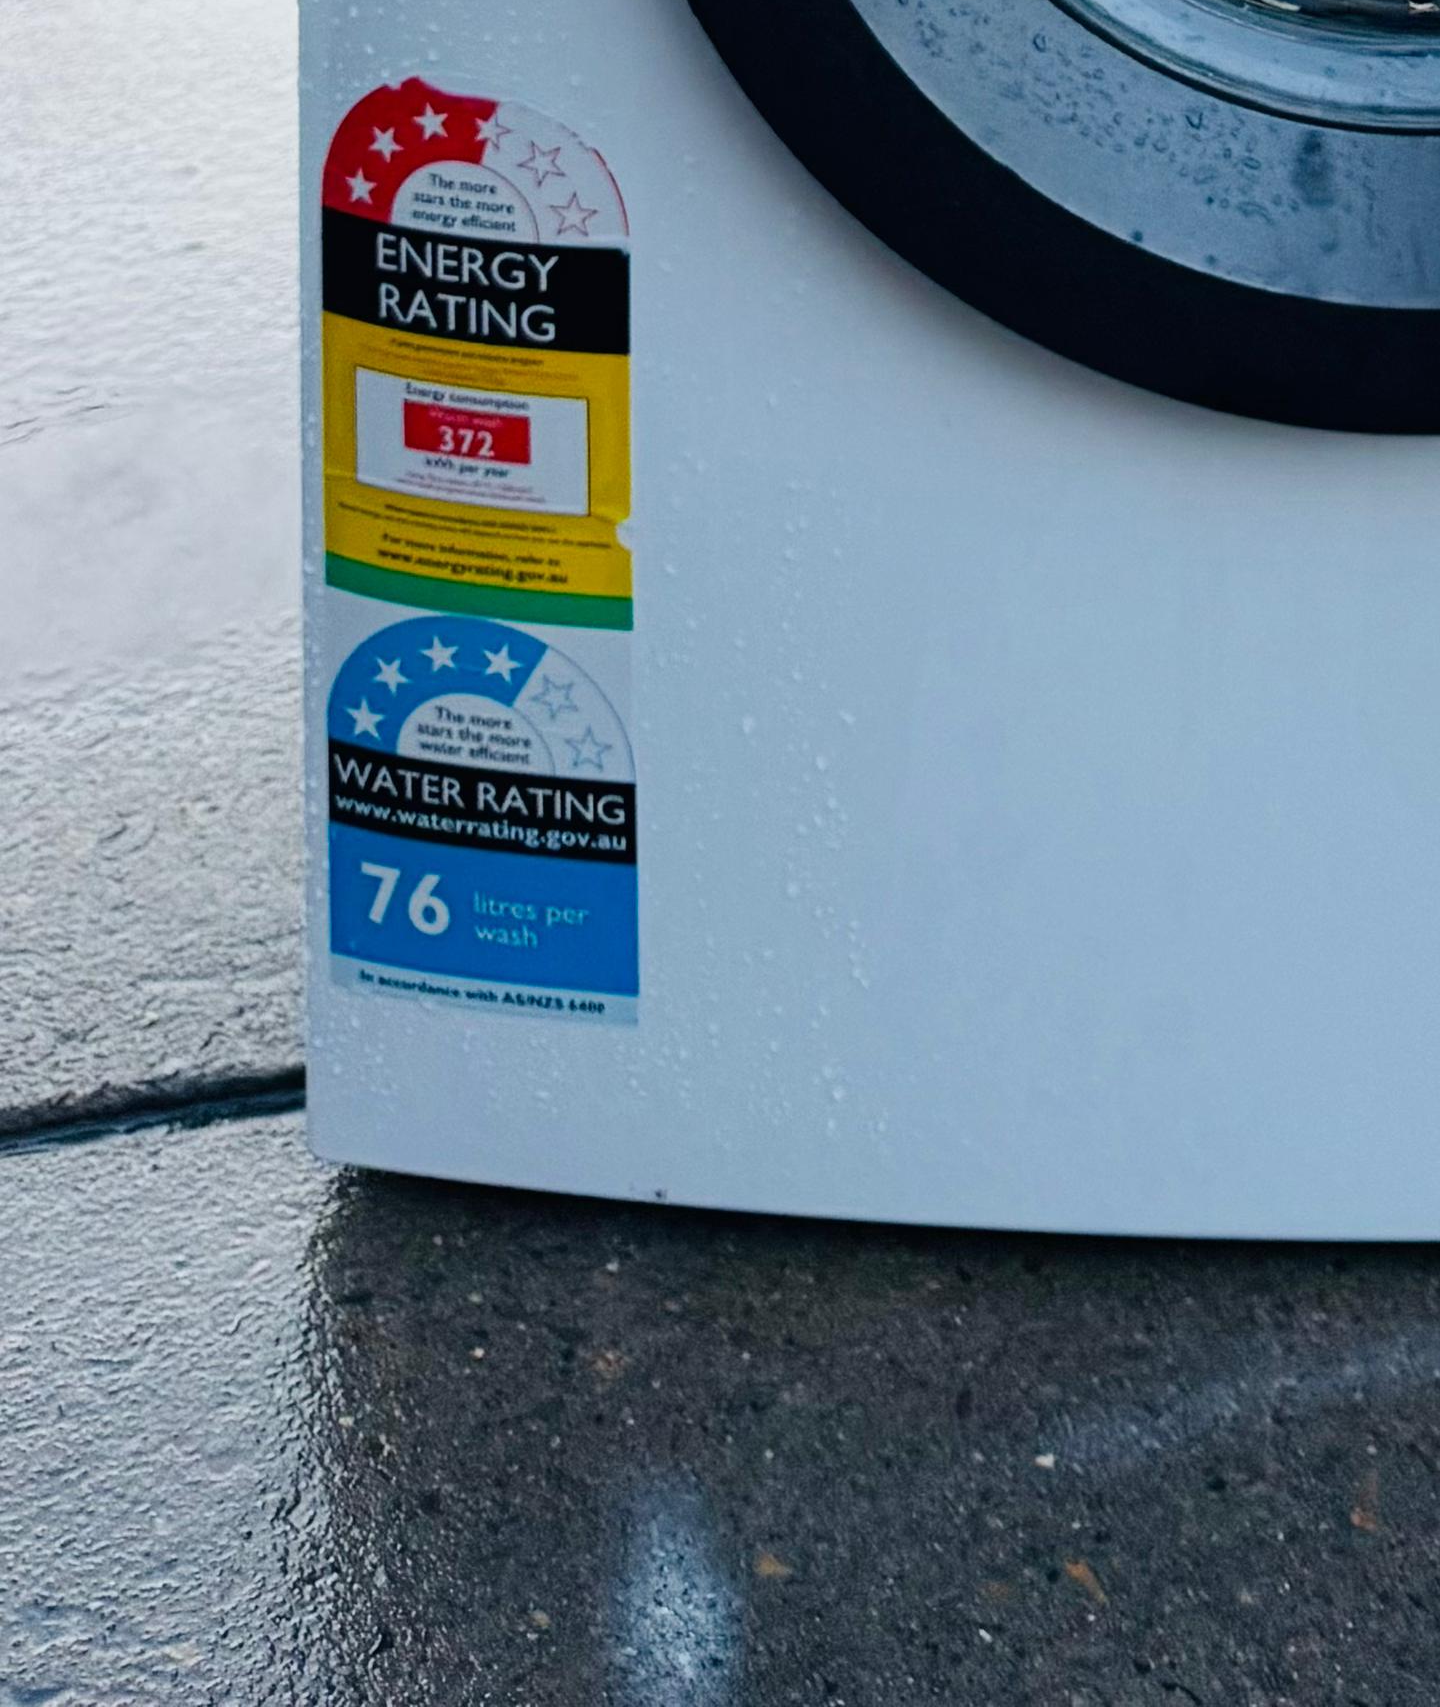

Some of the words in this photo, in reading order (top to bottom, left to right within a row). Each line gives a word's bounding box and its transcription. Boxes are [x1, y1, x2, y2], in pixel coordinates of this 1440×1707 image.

[429, 172, 455, 190] The
[460, 180, 497, 194] more
[413, 192, 445, 206] stars
[449, 195, 472, 209] the
[476, 201, 515, 214] more
[413, 209, 457, 228] energy
[461, 214, 516, 232] efficient
[375, 232, 559, 292] ENERGY
[378, 283, 556, 342] RATING
[438, 425, 495, 458] 372
[435, 705, 465, 724] The
[469, 715, 512, 729] more
[417, 723, 453, 739] stars
[458, 727, 484, 741] the
[488, 734, 531, 747] more
[332, 752, 465, 810] WATER
[476, 781, 626, 825] RATING
[334, 794, 627, 852] www.waterrating.gov.au
[360, 862, 451, 936] 76
[473, 892, 536, 921] litres
[546, 905, 590, 927] per
[474, 923, 539, 948] wash
[466, 990, 498, 1003] with
